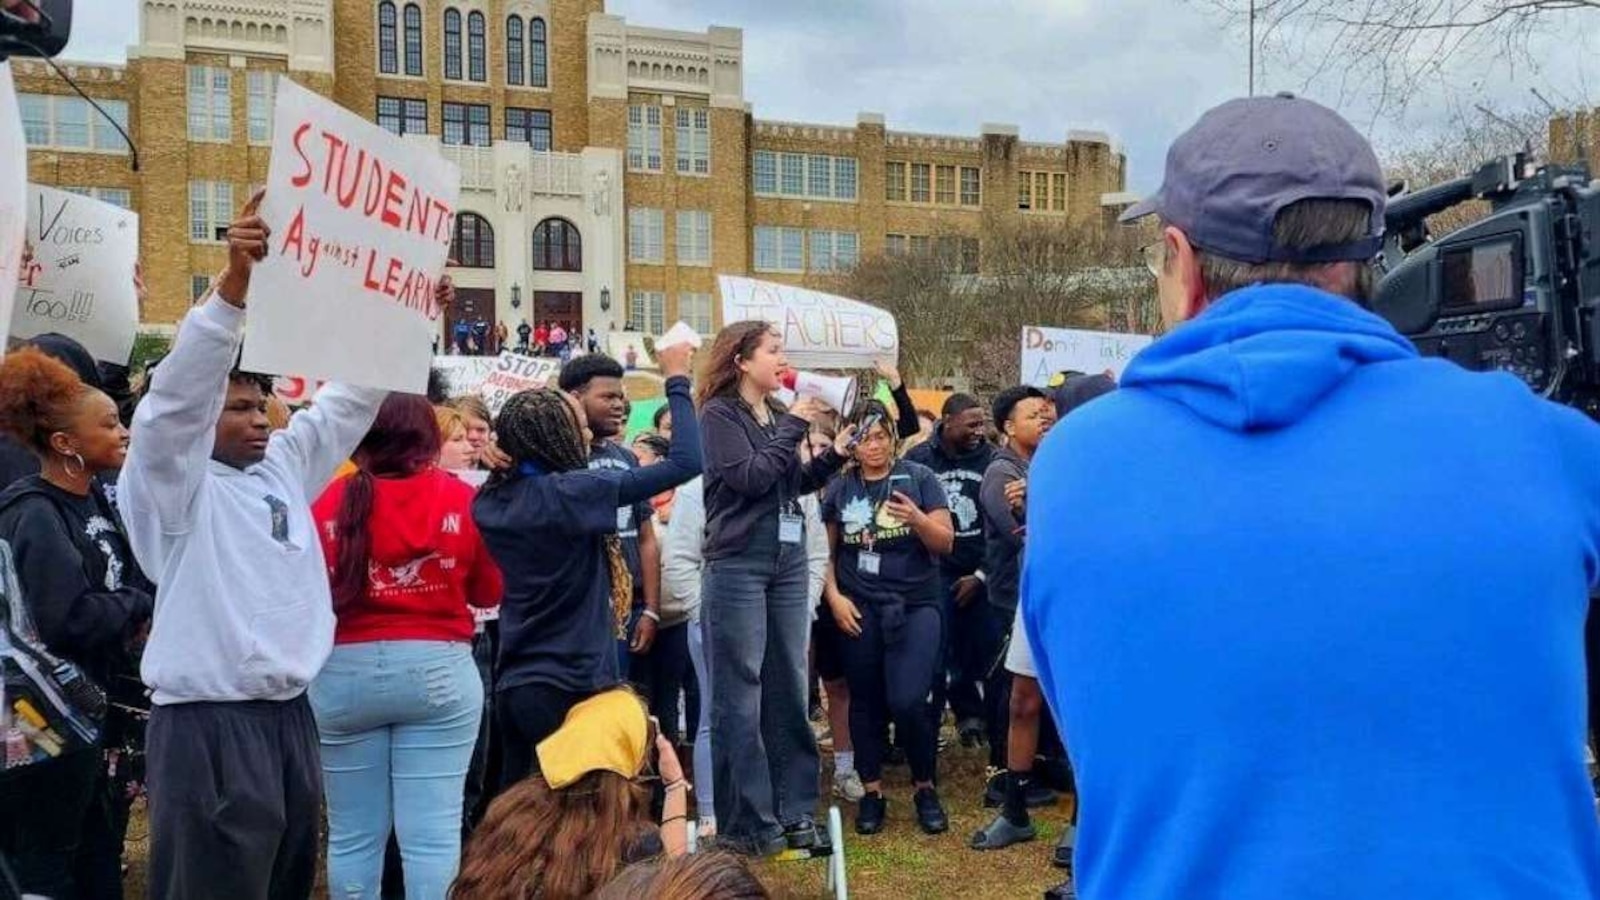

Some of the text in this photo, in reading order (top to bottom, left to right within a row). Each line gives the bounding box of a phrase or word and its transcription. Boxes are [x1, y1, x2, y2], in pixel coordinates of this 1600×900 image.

[290, 121, 455, 246] STUDENTS
[39, 192, 105, 245] Voices
[281, 203, 358, 278] Against
[497, 354, 551, 378] STOP
